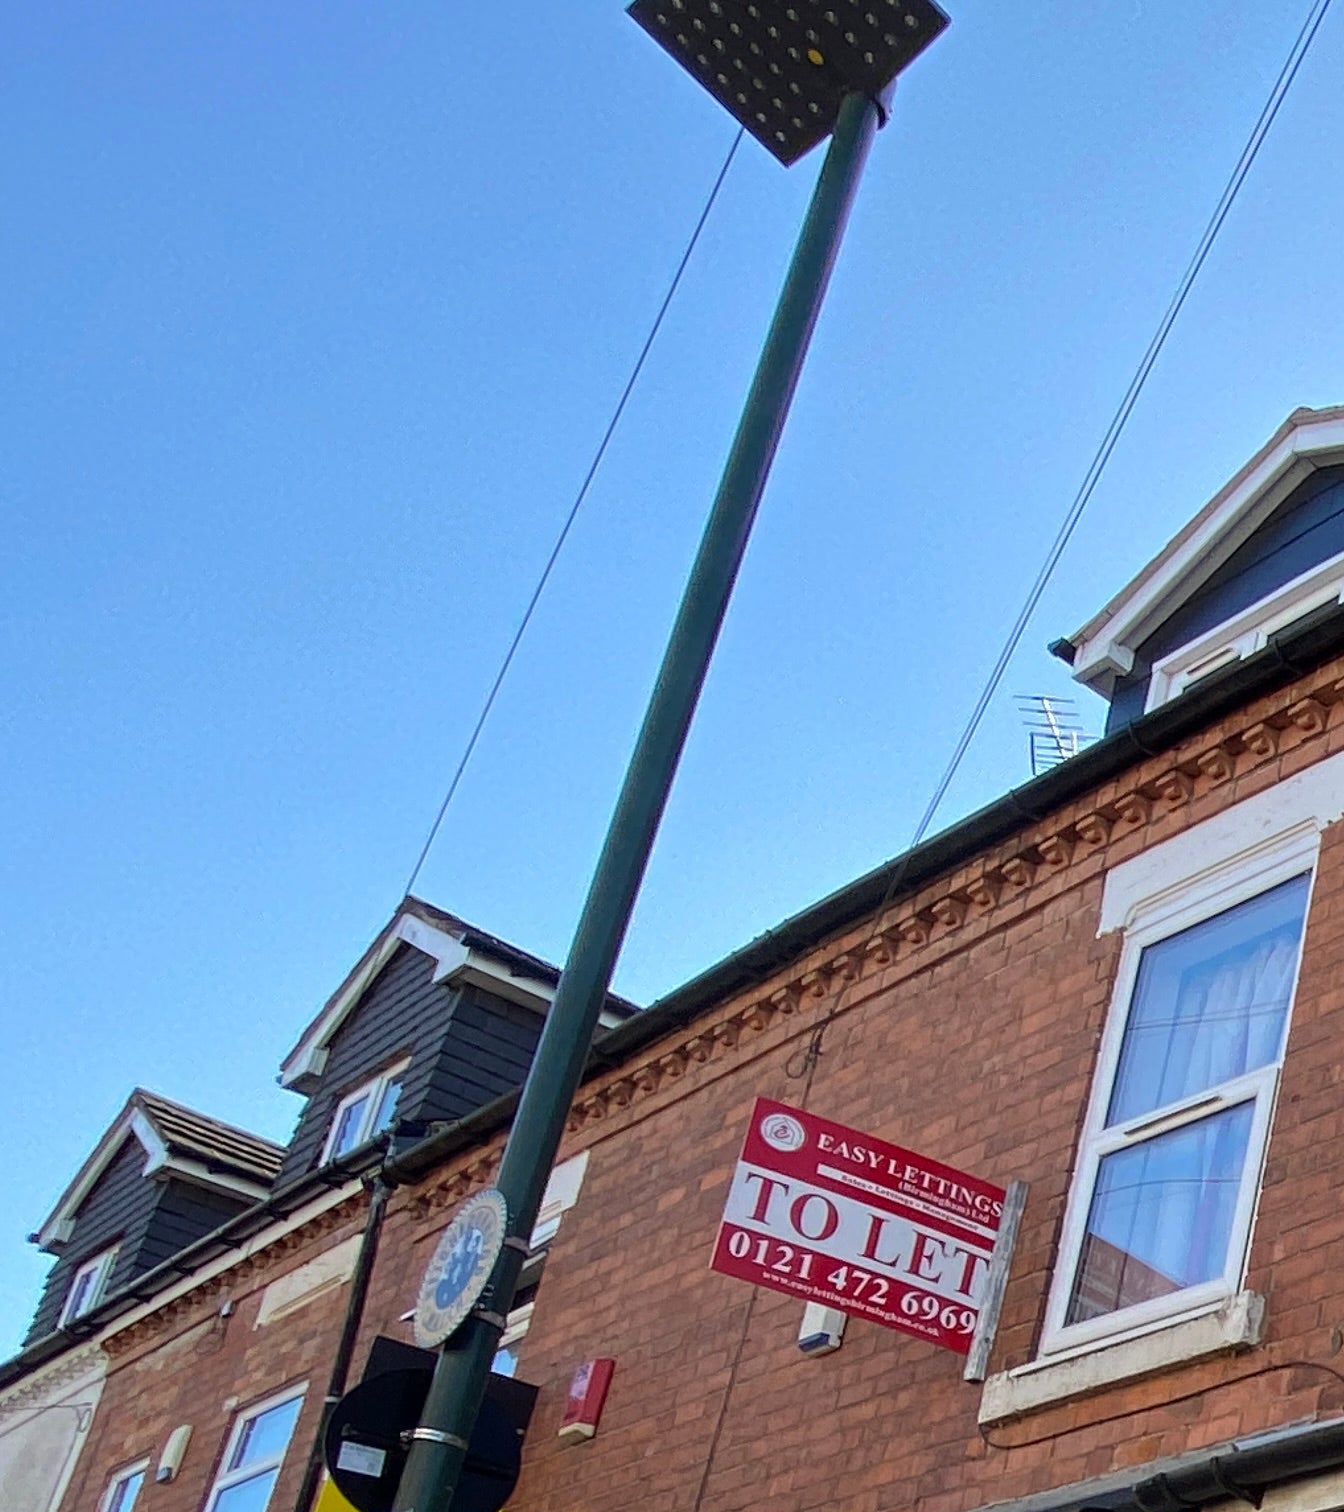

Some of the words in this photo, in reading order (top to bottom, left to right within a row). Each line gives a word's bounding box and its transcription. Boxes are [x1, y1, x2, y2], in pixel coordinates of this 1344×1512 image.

[817, 1132, 885, 1169] EASY
[886, 1158, 1004, 1218] LETTINGS
[728, 1231, 814, 1281] 0121
[827, 1265, 890, 1305] 472
[900, 1290, 978, 1335] 6969
[745, 1171, 840, 1242] TO
[857, 1212, 991, 1298] LET
